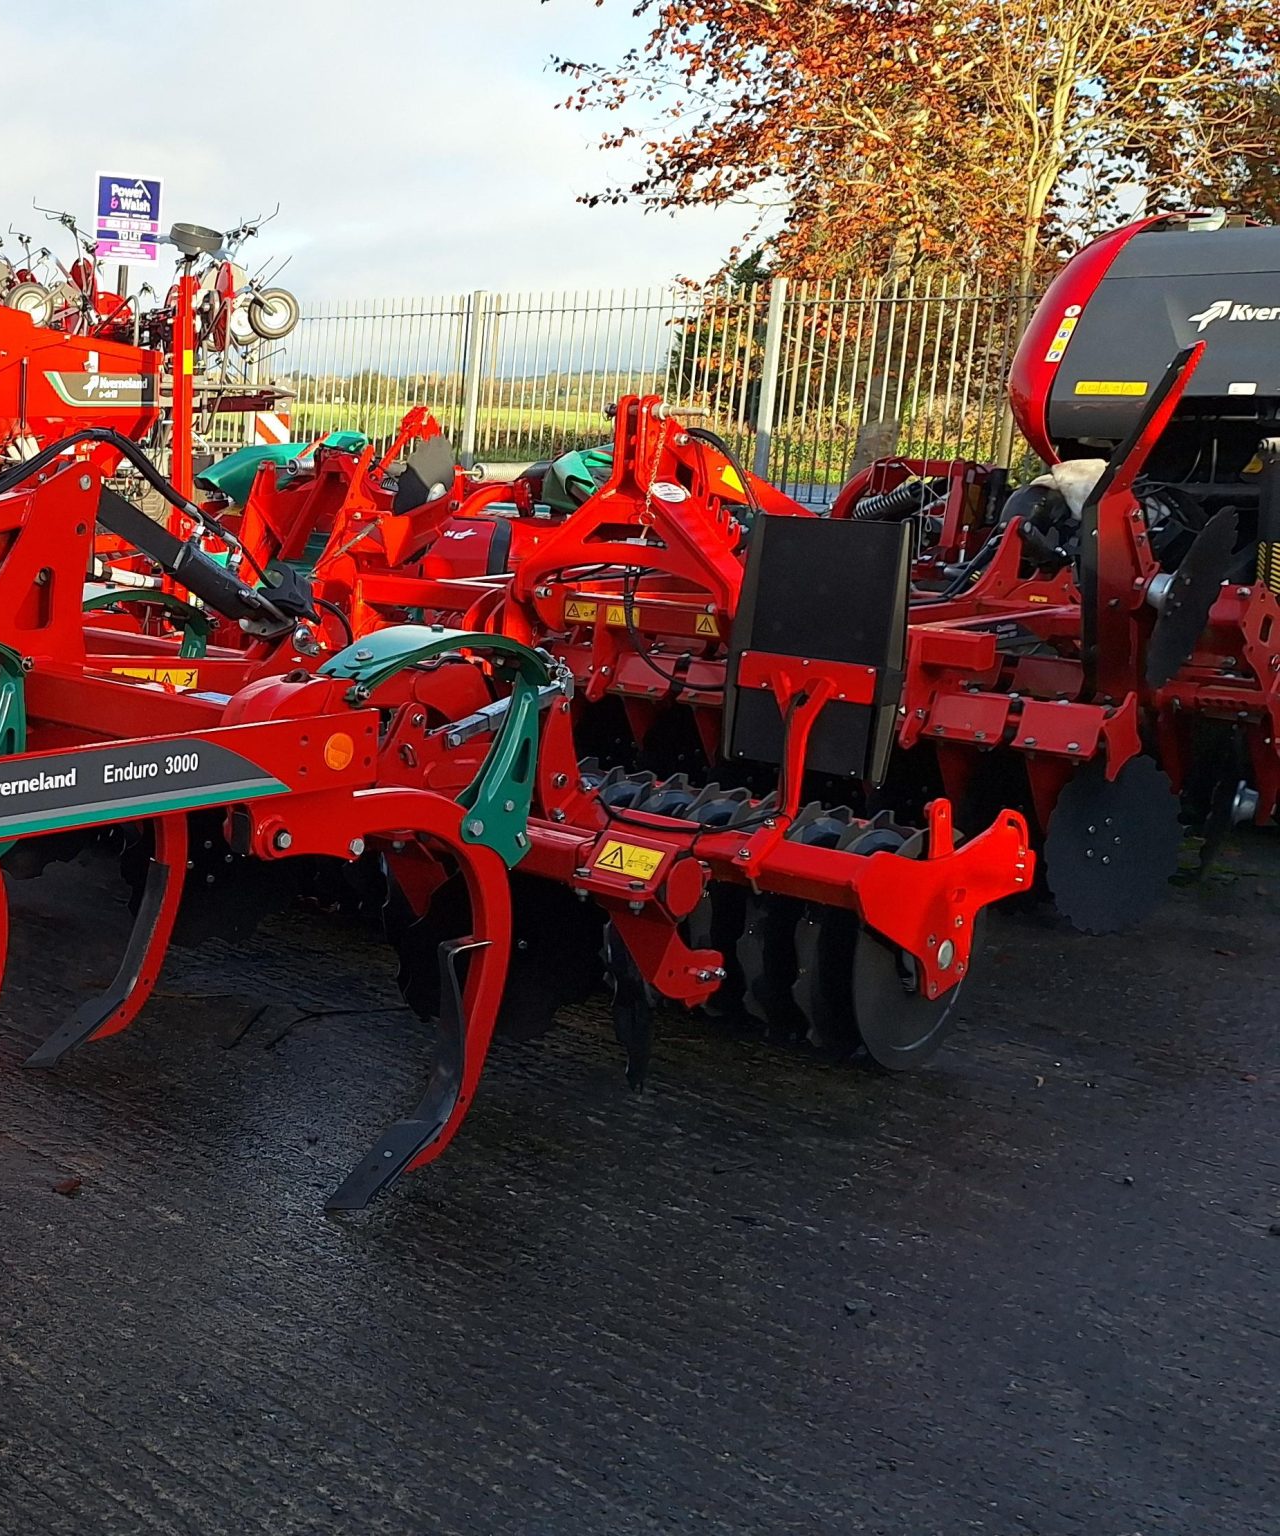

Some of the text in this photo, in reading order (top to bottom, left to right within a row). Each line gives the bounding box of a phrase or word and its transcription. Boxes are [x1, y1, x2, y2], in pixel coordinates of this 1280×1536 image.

[111, 183, 143, 198] Power
[120, 198, 150, 212] Walsh
[118, 231, 142, 241] TO LET
[103, 761, 158, 784] Enduro
[165, 753, 198, 775] 3000
